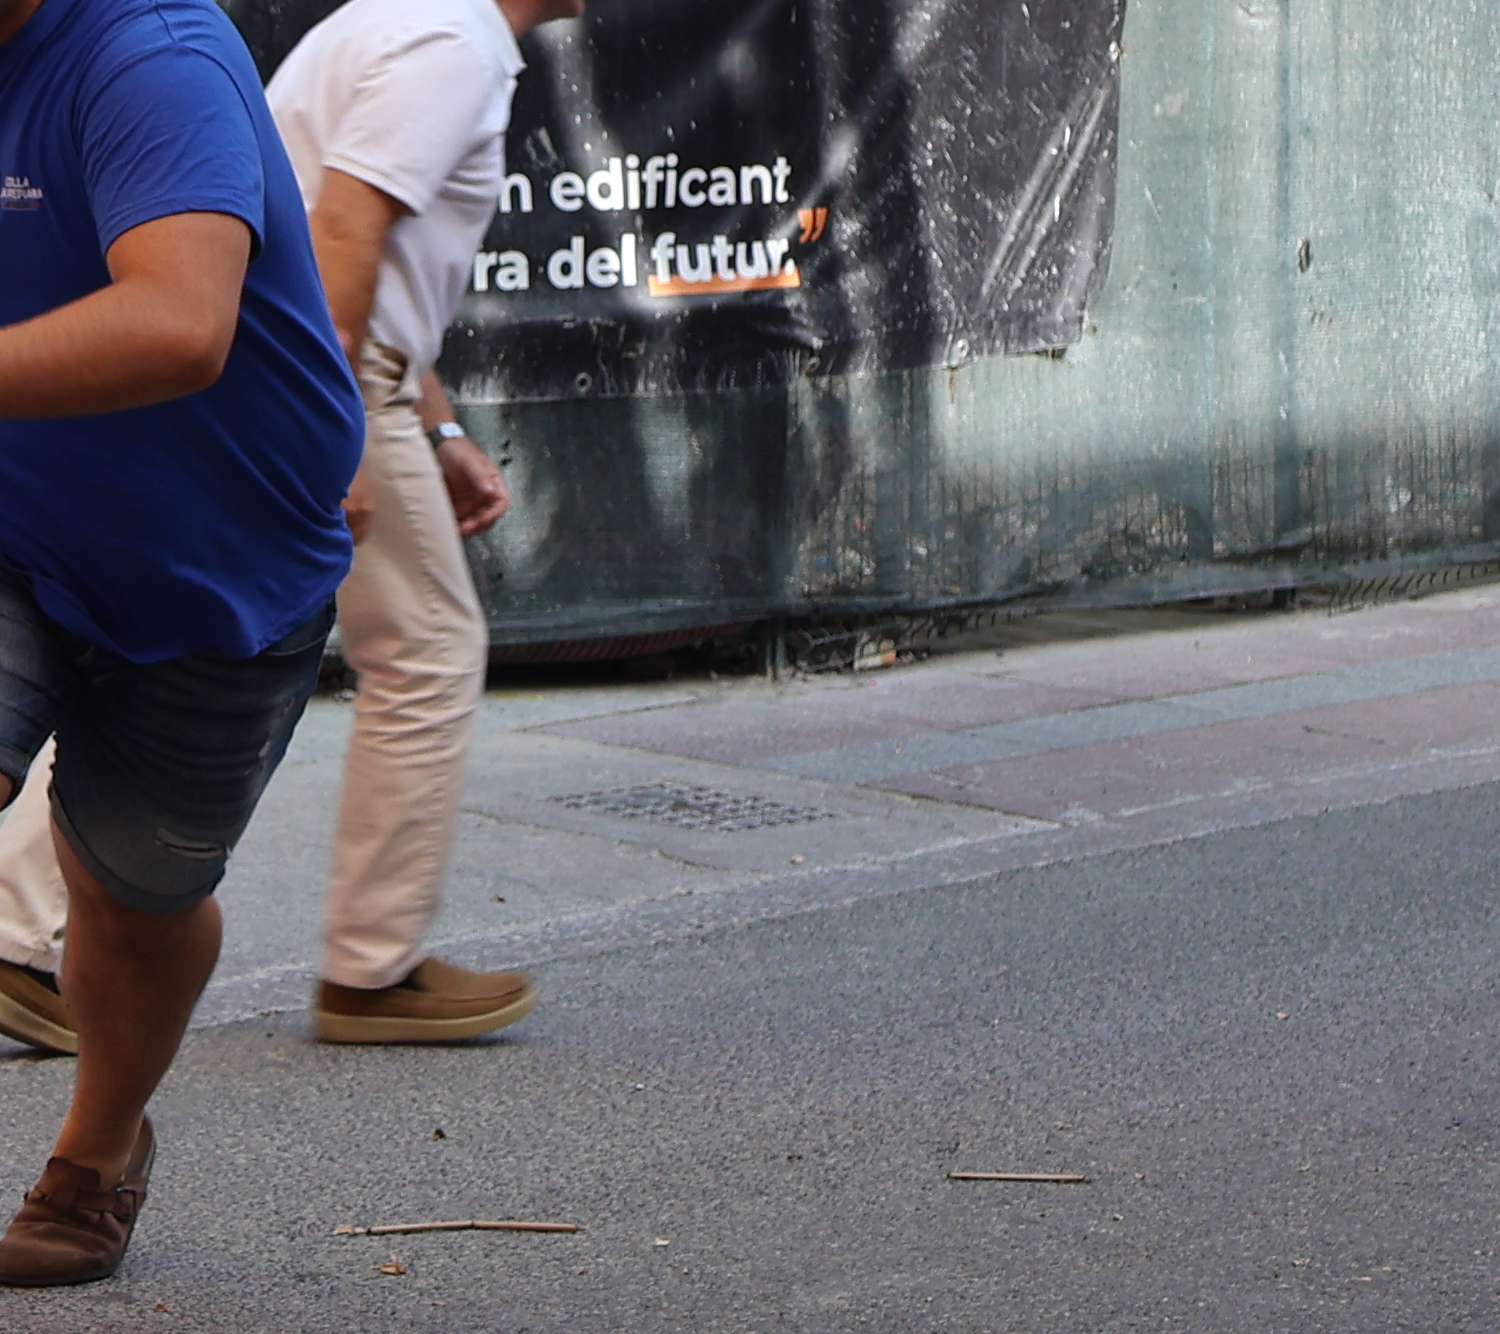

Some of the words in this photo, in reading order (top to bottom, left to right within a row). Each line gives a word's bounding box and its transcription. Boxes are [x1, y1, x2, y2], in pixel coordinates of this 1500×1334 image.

[497, 172, 534, 213] n
[550, 153, 791, 213] edificant
[473, 250, 531, 292] ra
[547, 232, 638, 288] del
